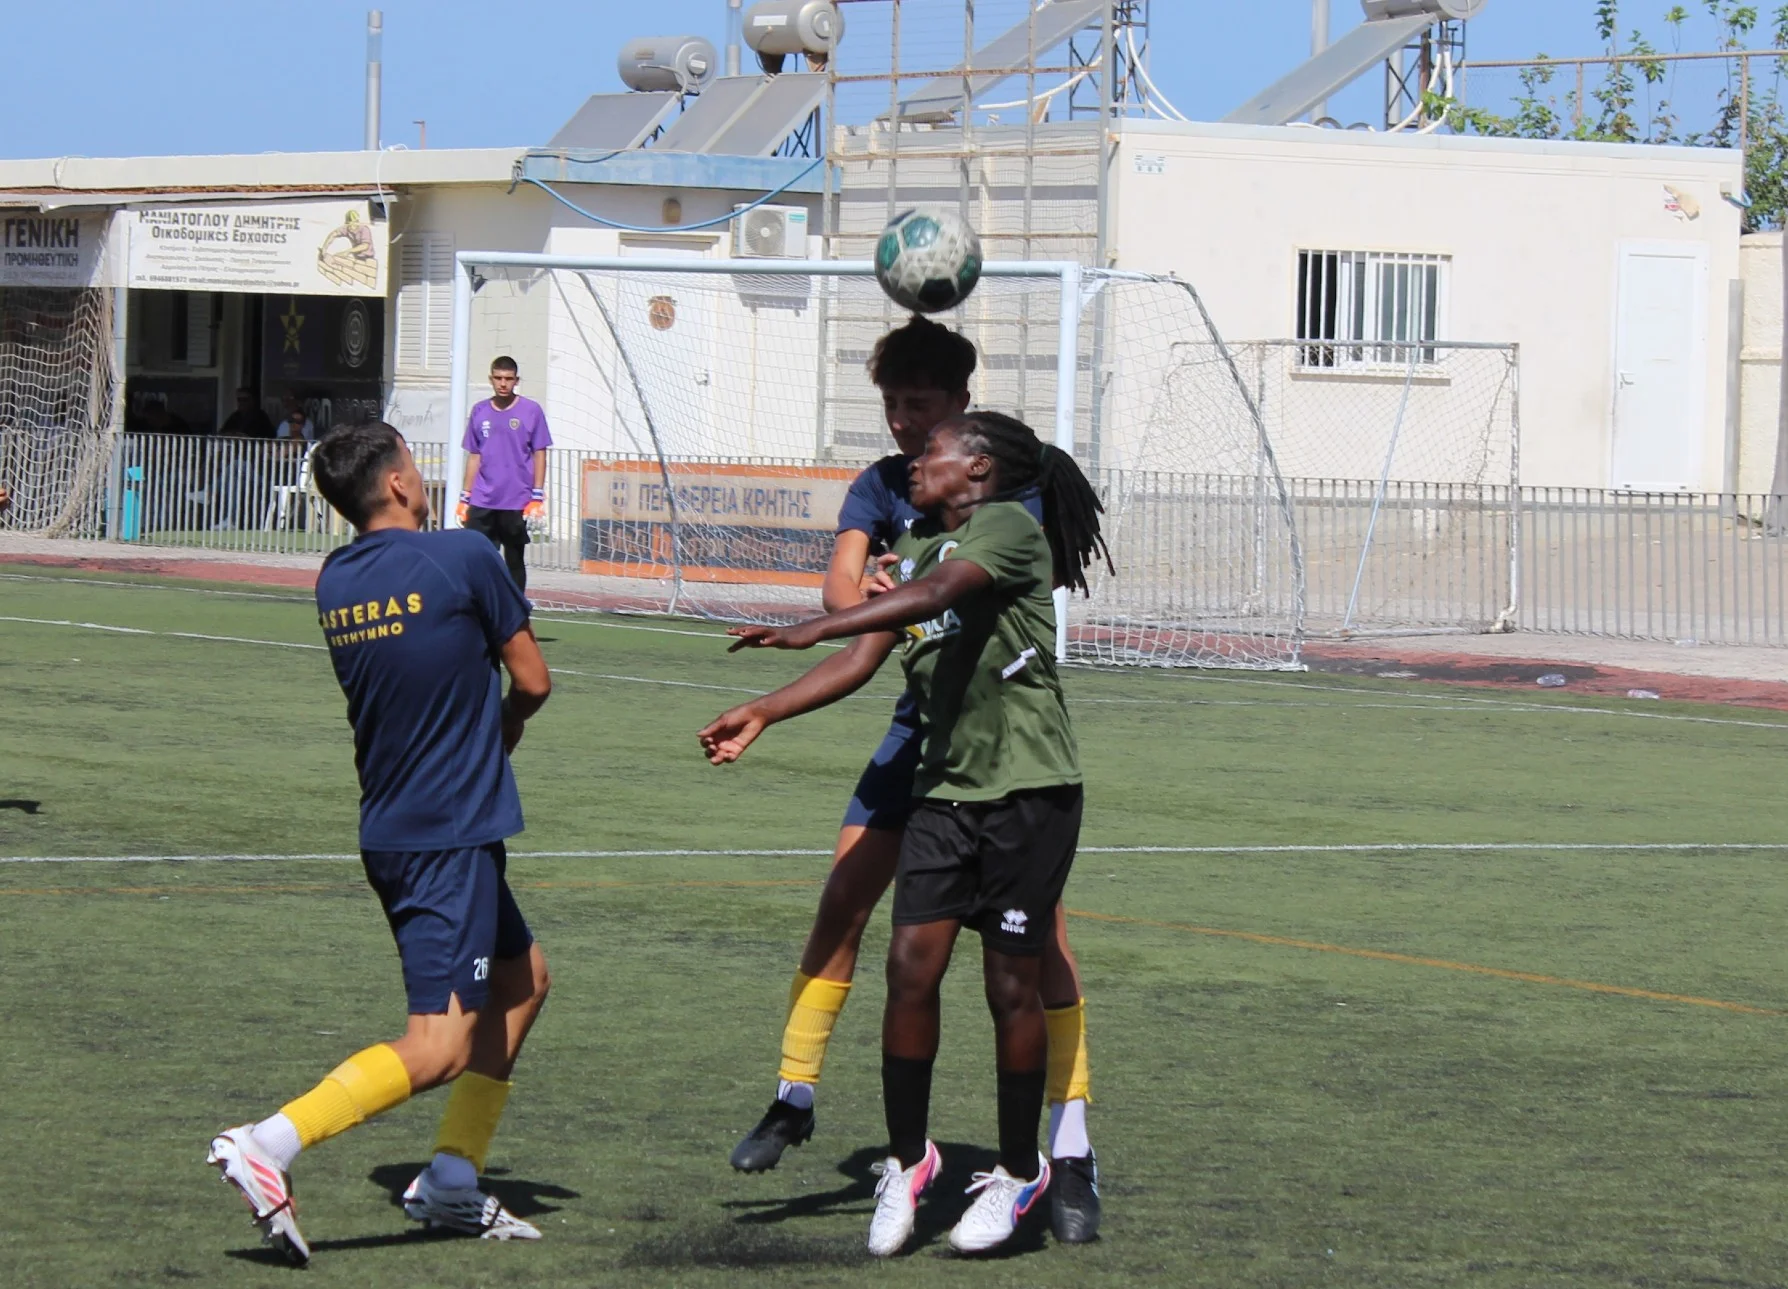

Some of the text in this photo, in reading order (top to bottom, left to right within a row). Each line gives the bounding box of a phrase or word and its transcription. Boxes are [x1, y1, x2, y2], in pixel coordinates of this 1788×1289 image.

[5, 218, 79, 248] ΓΕΝΙΚΗ
[640, 483, 812, 519] ΠΕΡΦΕΡΕΙΑ ΚΡΗΤΗΣ
[322, 593, 421, 629] ASTERAS
[473, 956, 489, 981] 26
